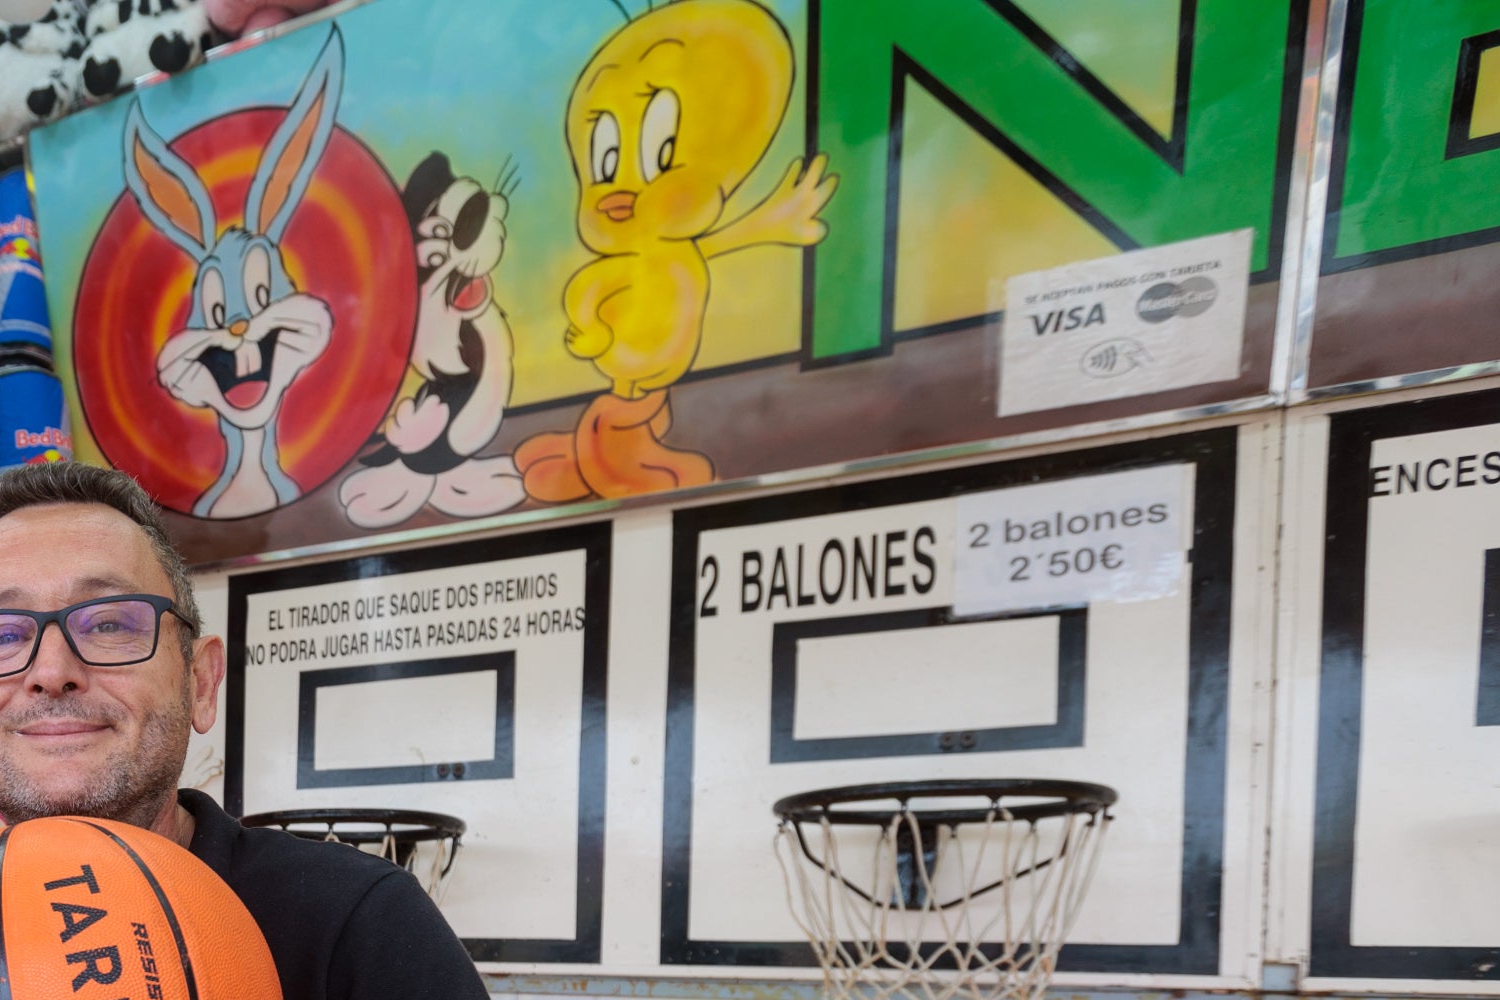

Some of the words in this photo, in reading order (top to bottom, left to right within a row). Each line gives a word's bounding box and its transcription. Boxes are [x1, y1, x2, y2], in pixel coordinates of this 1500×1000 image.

[1031, 302, 1106, 336] VISA
[969, 523, 990, 549] 2
[1004, 502, 1169, 544] balones
[700, 555, 720, 617] 2
[740, 525, 937, 613] BALONES
[268, 610, 284, 632] EL
[289, 601, 350, 629] TIRADOR
[355, 596, 385, 621] QUE
[390, 589, 441, 615] SAQUE
[446, 583, 478, 609] DOS
[484, 573, 558, 604] PREMIOS
[245, 643, 266, 667] NO
[270, 639, 317, 664] PODRA
[321, 632, 369, 659] JUGAR
[374, 624, 422, 653] HASTA
[428, 617, 498, 646] PASADAS
[503, 615, 521, 640] 24
[526, 606, 587, 637] HORAS
